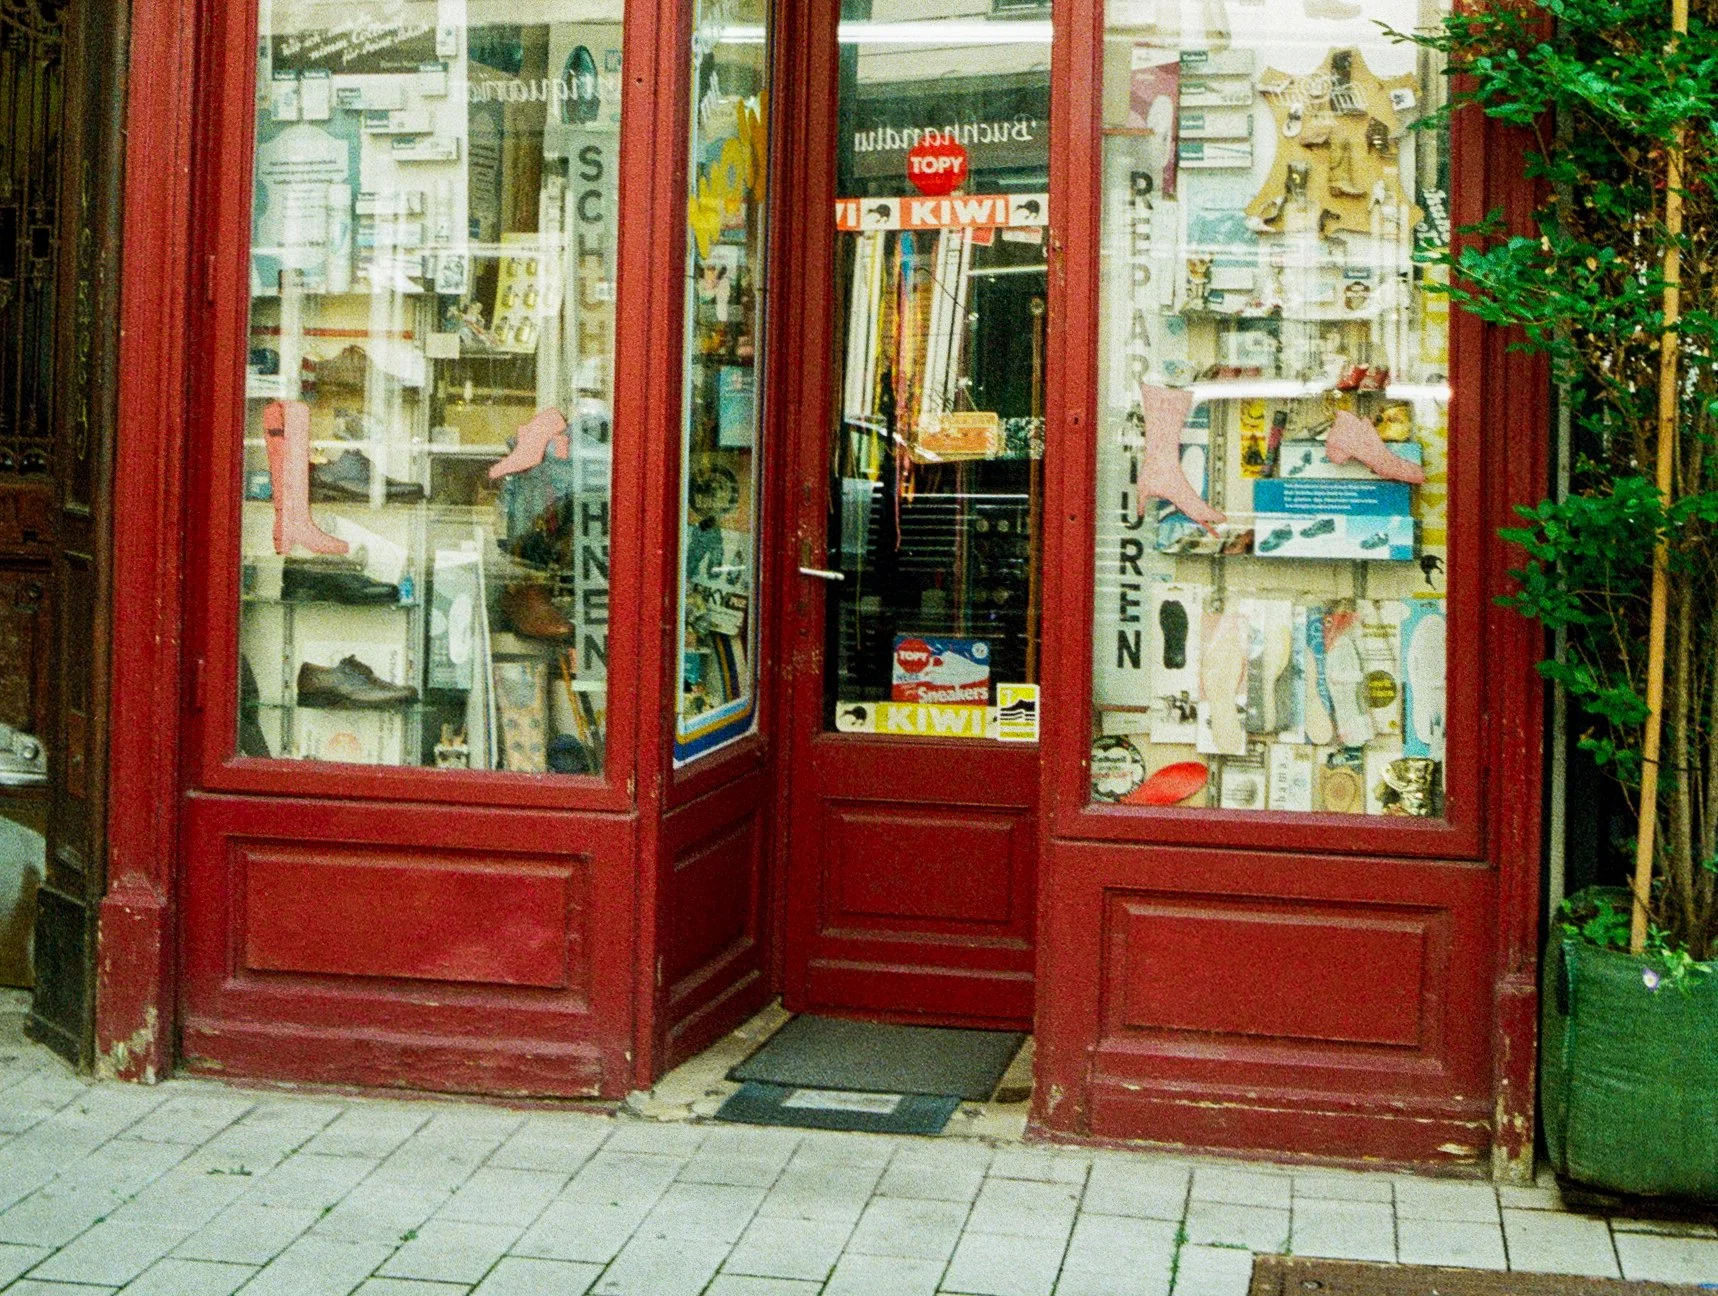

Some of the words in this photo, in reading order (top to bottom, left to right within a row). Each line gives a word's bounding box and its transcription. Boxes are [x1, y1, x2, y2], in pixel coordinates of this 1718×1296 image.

[910, 156, 964, 174] TOPY
[911, 199, 1006, 225] KIWI
[917, 687, 989, 705] Sneakers
[888, 706, 983, 734] KIWI
